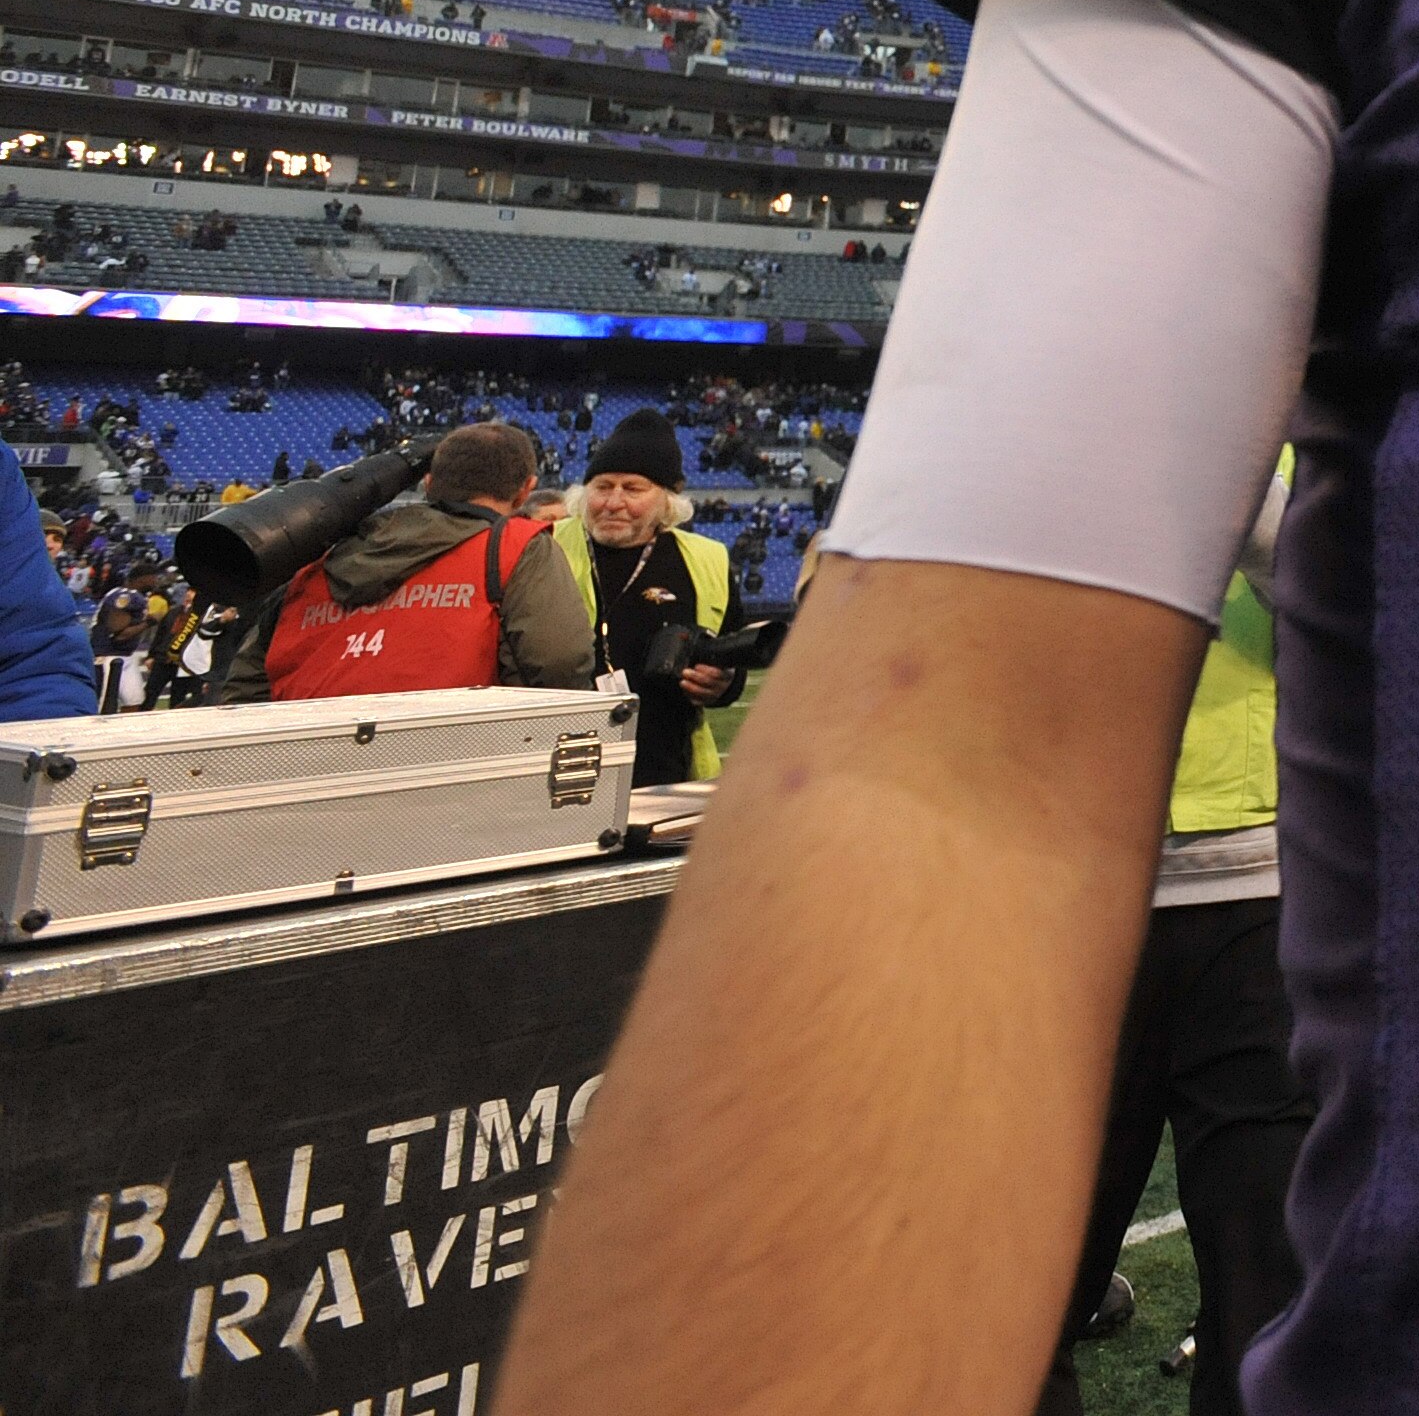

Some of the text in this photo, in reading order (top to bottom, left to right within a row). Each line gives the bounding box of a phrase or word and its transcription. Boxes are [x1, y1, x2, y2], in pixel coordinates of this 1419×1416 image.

[249, 2, 336, 28] NORTH
[346, 15, 481, 46] CHAMPIONS
[1, 70, 90, 91] ODELL
[135, 84, 348, 119] EARNEST BYNER
[391, 110, 590, 144] PETER BOULWARE
[824, 153, 908, 172] SMYTH
[301, 583, 475, 631] PHOAPHER
[180, 1188, 562, 1378] RAVE
